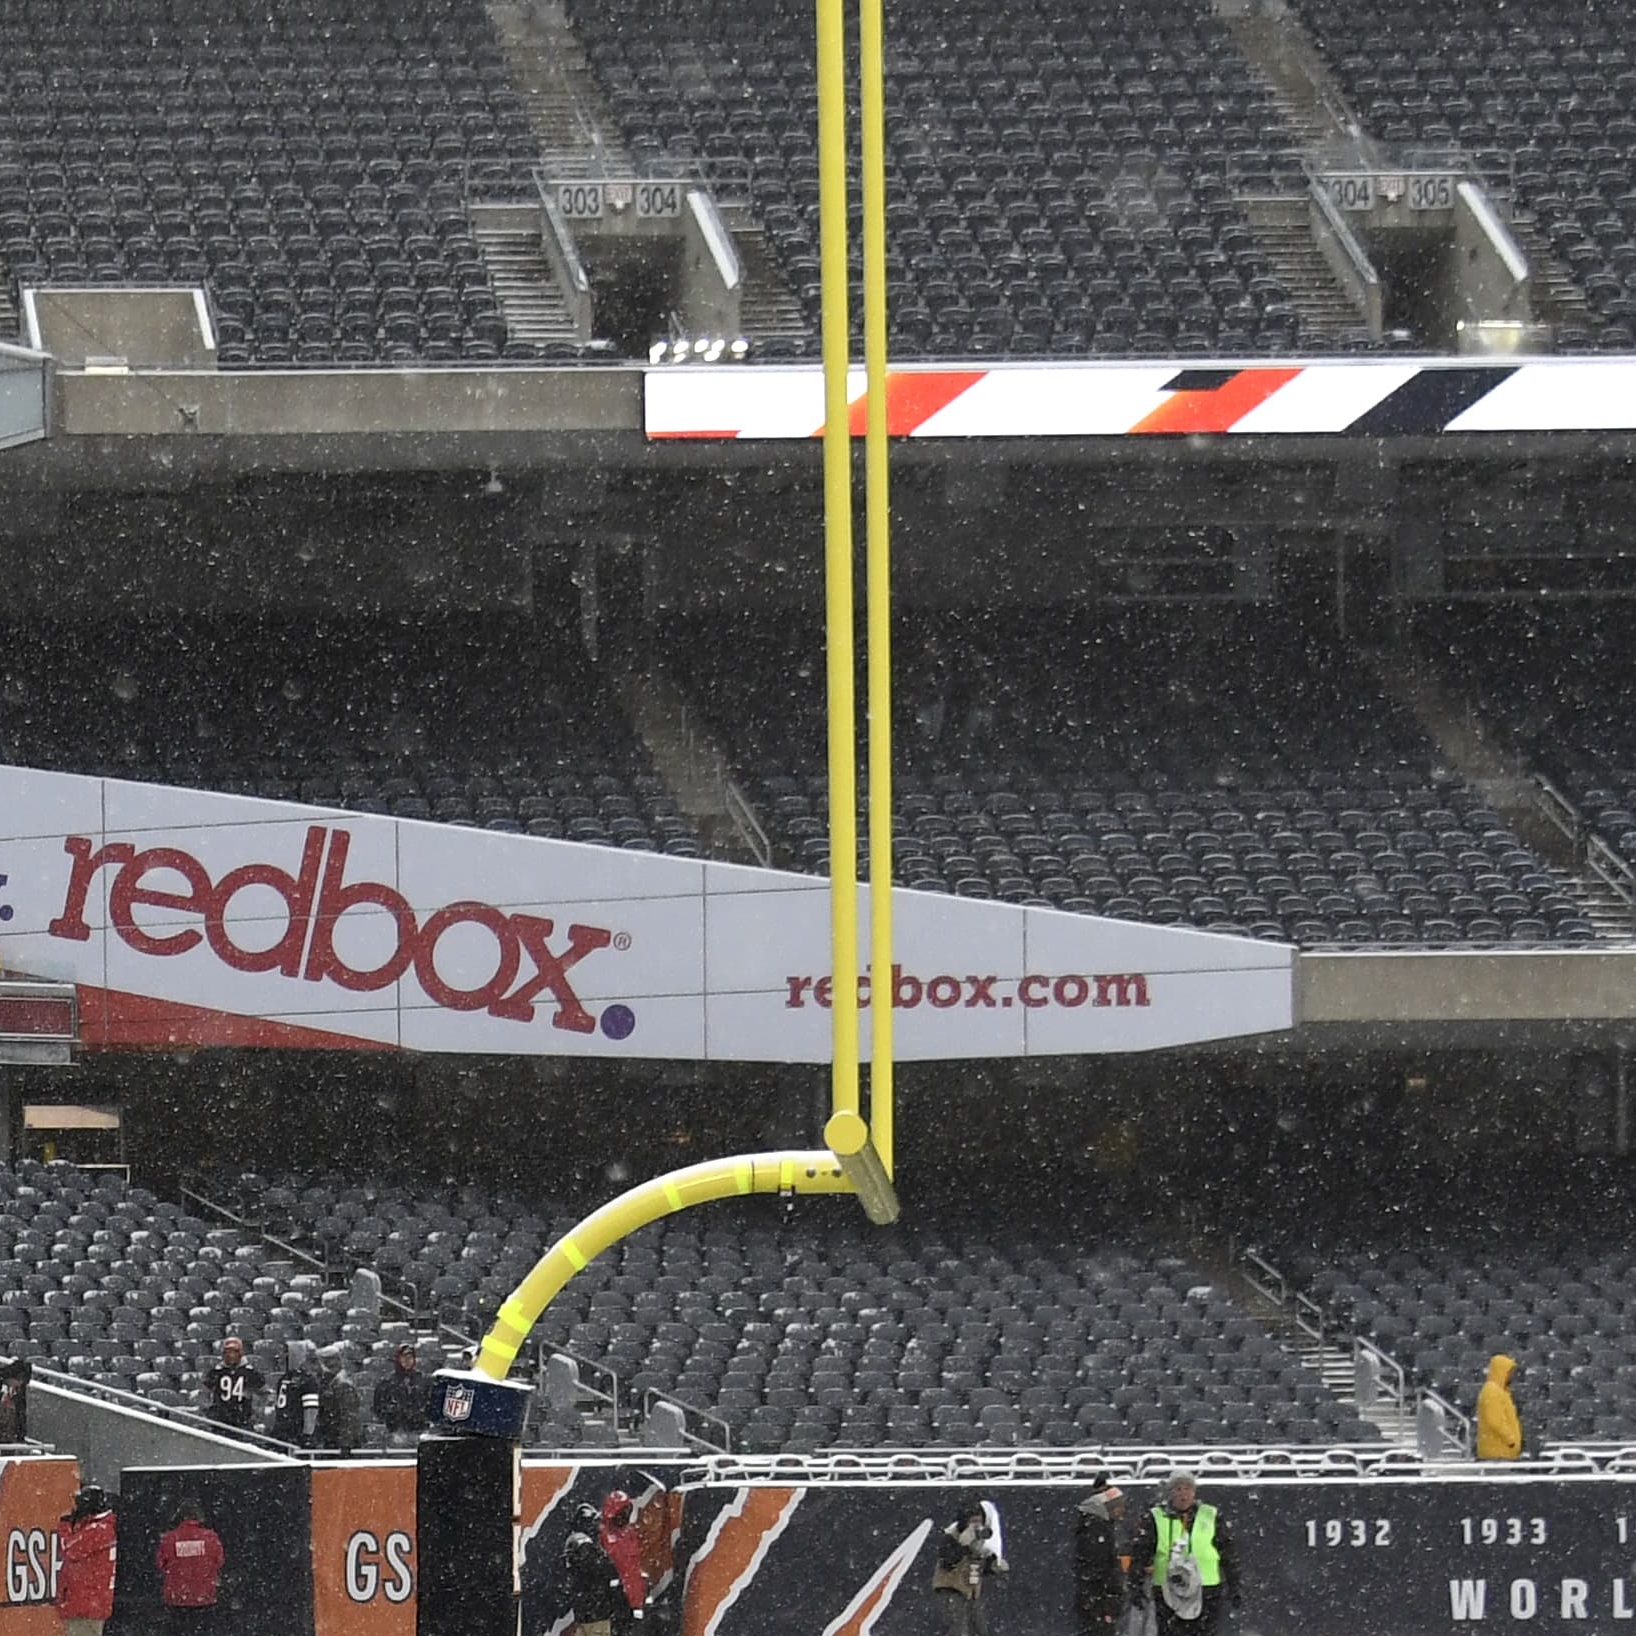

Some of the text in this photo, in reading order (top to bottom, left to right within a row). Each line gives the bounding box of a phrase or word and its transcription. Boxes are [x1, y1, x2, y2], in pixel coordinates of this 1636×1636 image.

[562, 187, 677, 215] 303 304
[220, 1375, 245, 1402] 94
[447, 1399, 467, 1416] NFL
[1305, 1517, 1547, 1547] 1932 1933
[346, 1530, 413, 1603] GS
[1449, 1577, 1634, 1620] WORL
